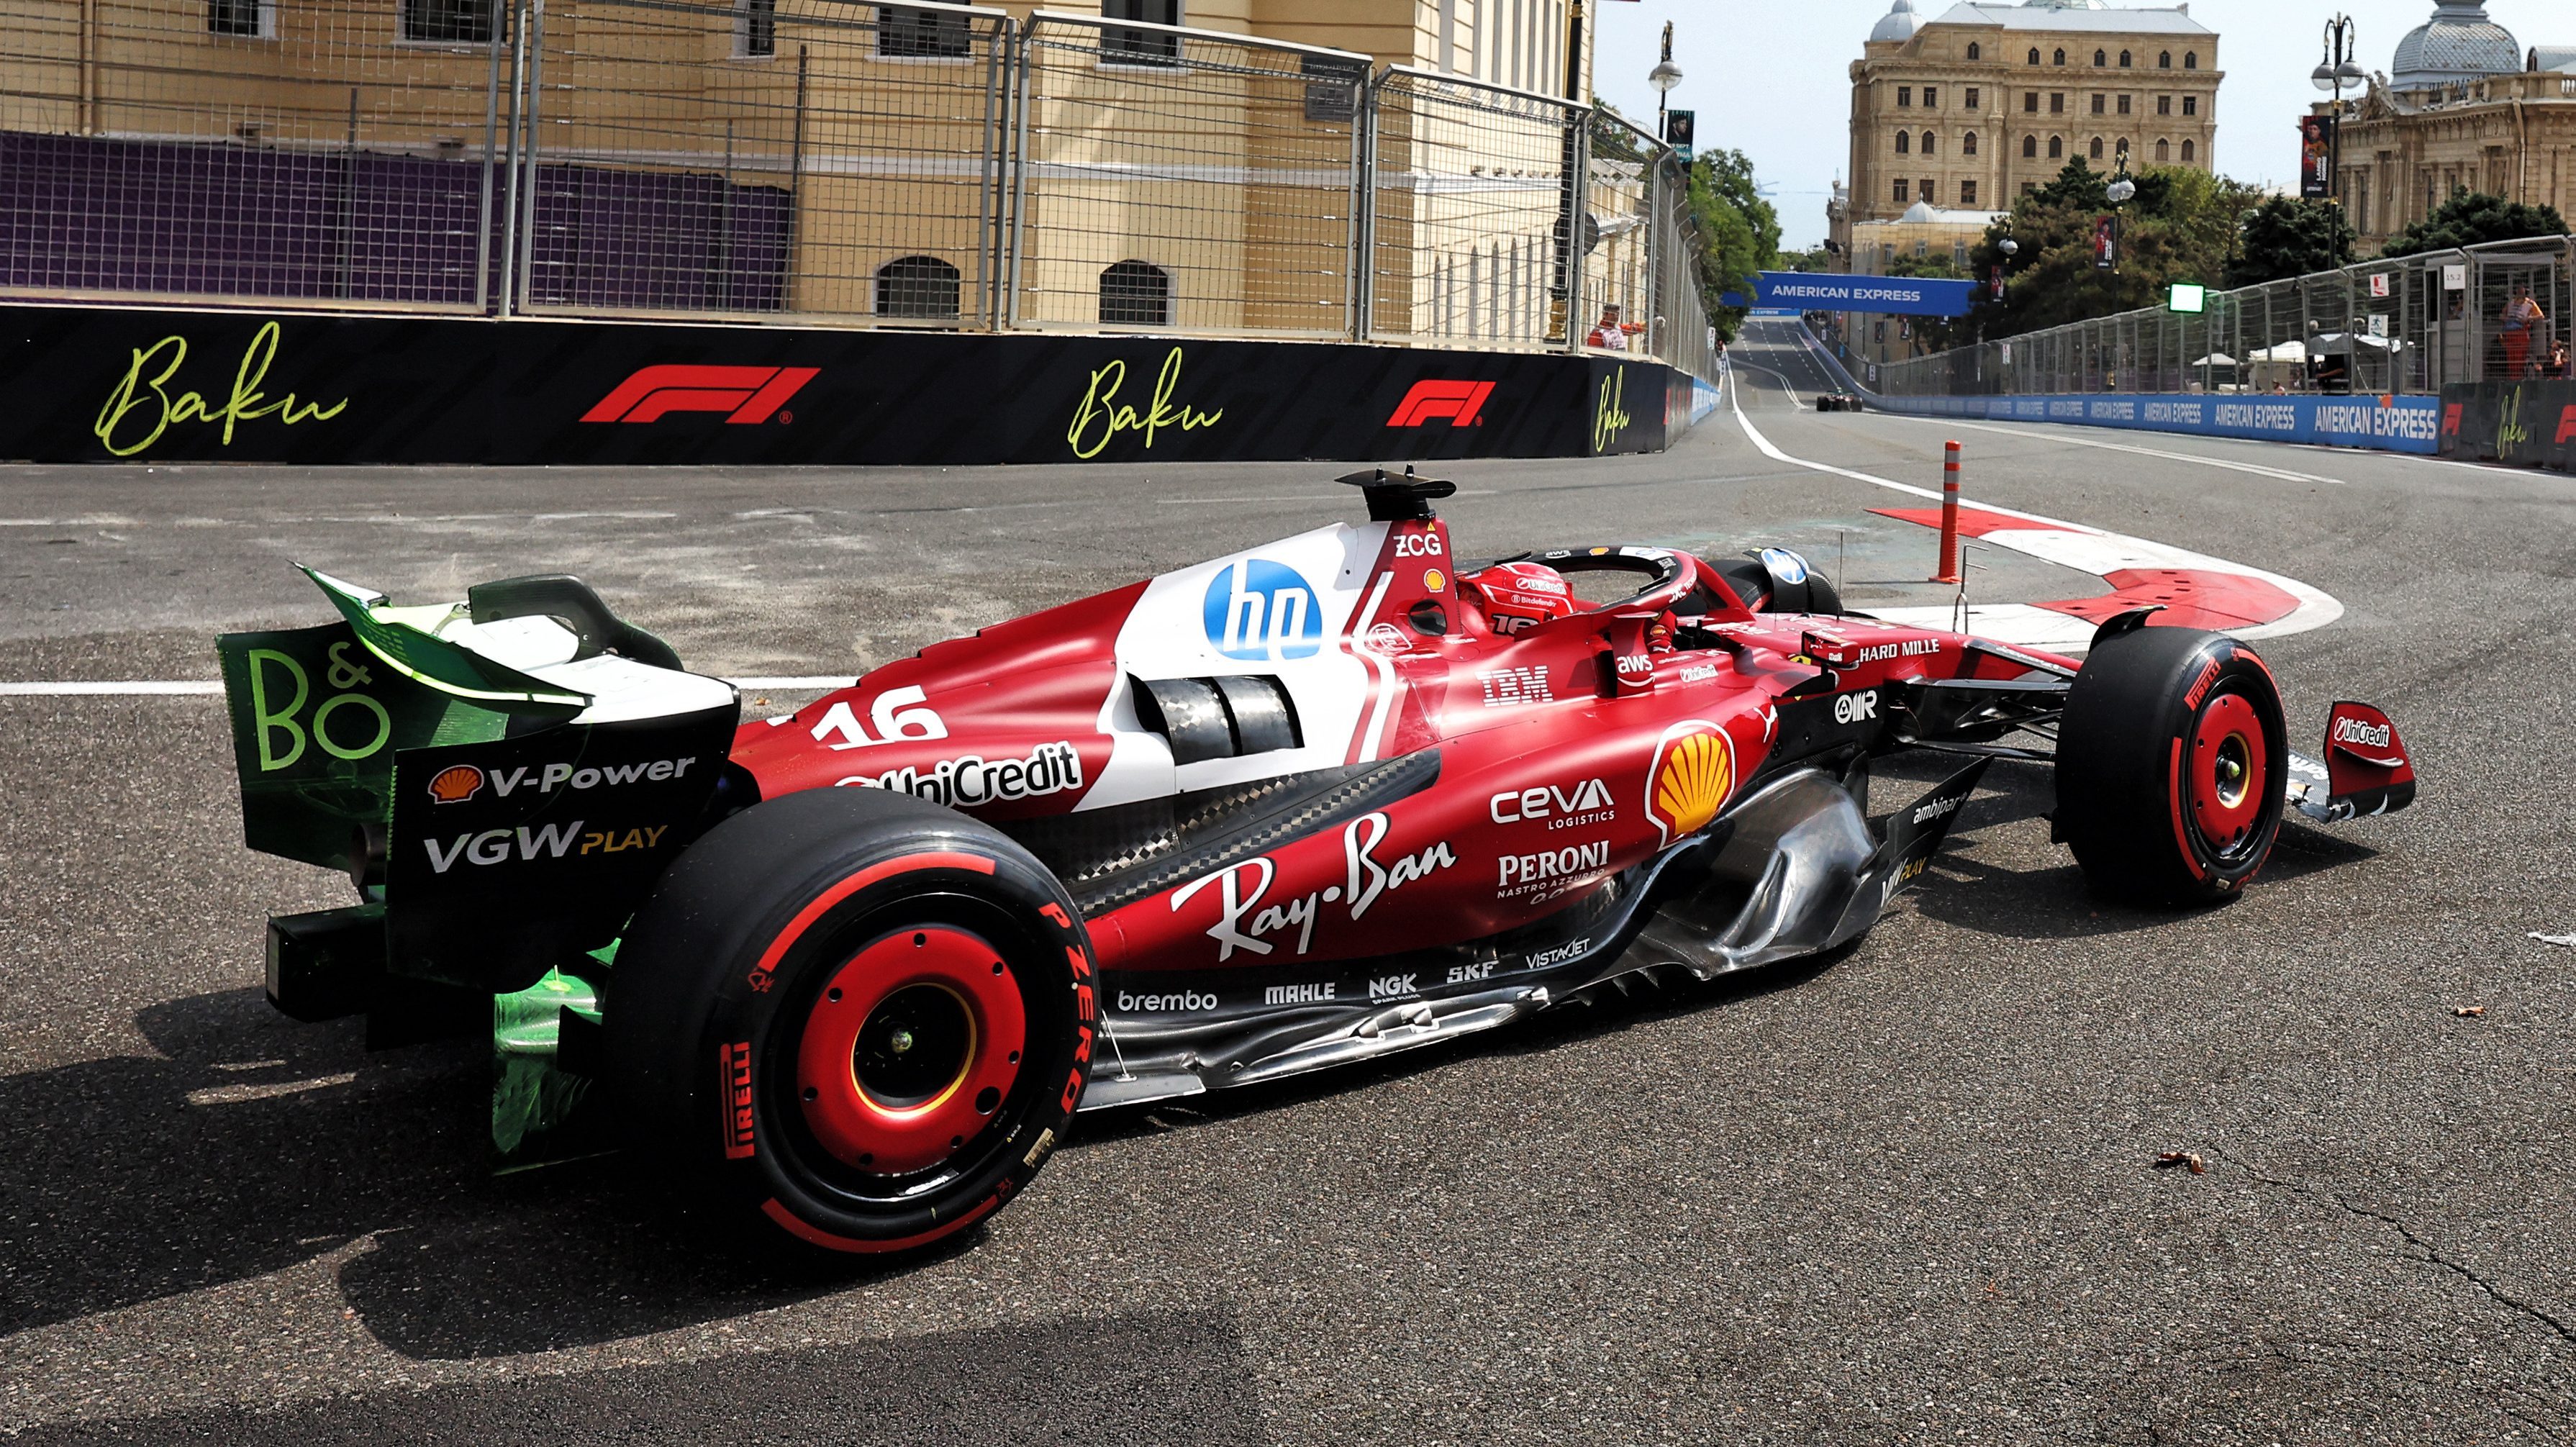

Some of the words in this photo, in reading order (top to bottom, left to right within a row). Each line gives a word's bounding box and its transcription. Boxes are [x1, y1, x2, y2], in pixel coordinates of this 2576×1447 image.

[1772, 285, 1848, 299] AMERICAN
[1854, 289, 1920, 301] EXPRESS
[95, 321, 349, 456] Baku
[579, 364, 822, 424] F1
[1068, 347, 1223, 458] Baku
[1386, 379, 1497, 427] F1
[1595, 365, 1630, 453] Baku
[2144, 402, 2172, 422] AMERICAN
[2172, 403, 2201, 424] EXPRESS
[2215, 404, 2254, 427] AMERICAN
[2255, 405, 2295, 430] EXPRESS
[2314, 406, 2371, 435] AMERICAN
[2375, 407, 2436, 440] EXPRESS
[1221, 558, 1312, 661] hp
[1617, 655, 1653, 673] aws
[1902, 639, 1939, 656] MILLE
[1474, 665, 1554, 707] IBM
[2184, 656, 2221, 712] PIRELLI
[810, 684, 948, 750] 16
[2345, 720, 2389, 746] UniCredit
[489, 756, 696, 797] V-Power
[1548, 810, 1615, 830] LOGISTICS
[1913, 797, 1959, 825] ambipar
[1498, 840, 1610, 887] PERONI
[1497, 881, 1547, 899] NASTRO
[1549, 868, 1605, 888] AZZURRO
[1369, 972, 1417, 999] NGK
[1446, 960, 1500, 984] SKF
[1038, 902, 1071, 929] P
[1060, 944, 1094, 1115] ZERO
[1117, 989, 1217, 1012] brembo
[1265, 981, 1336, 1005] MAHLE
[720, 1041, 755, 1160] PIRELLI
